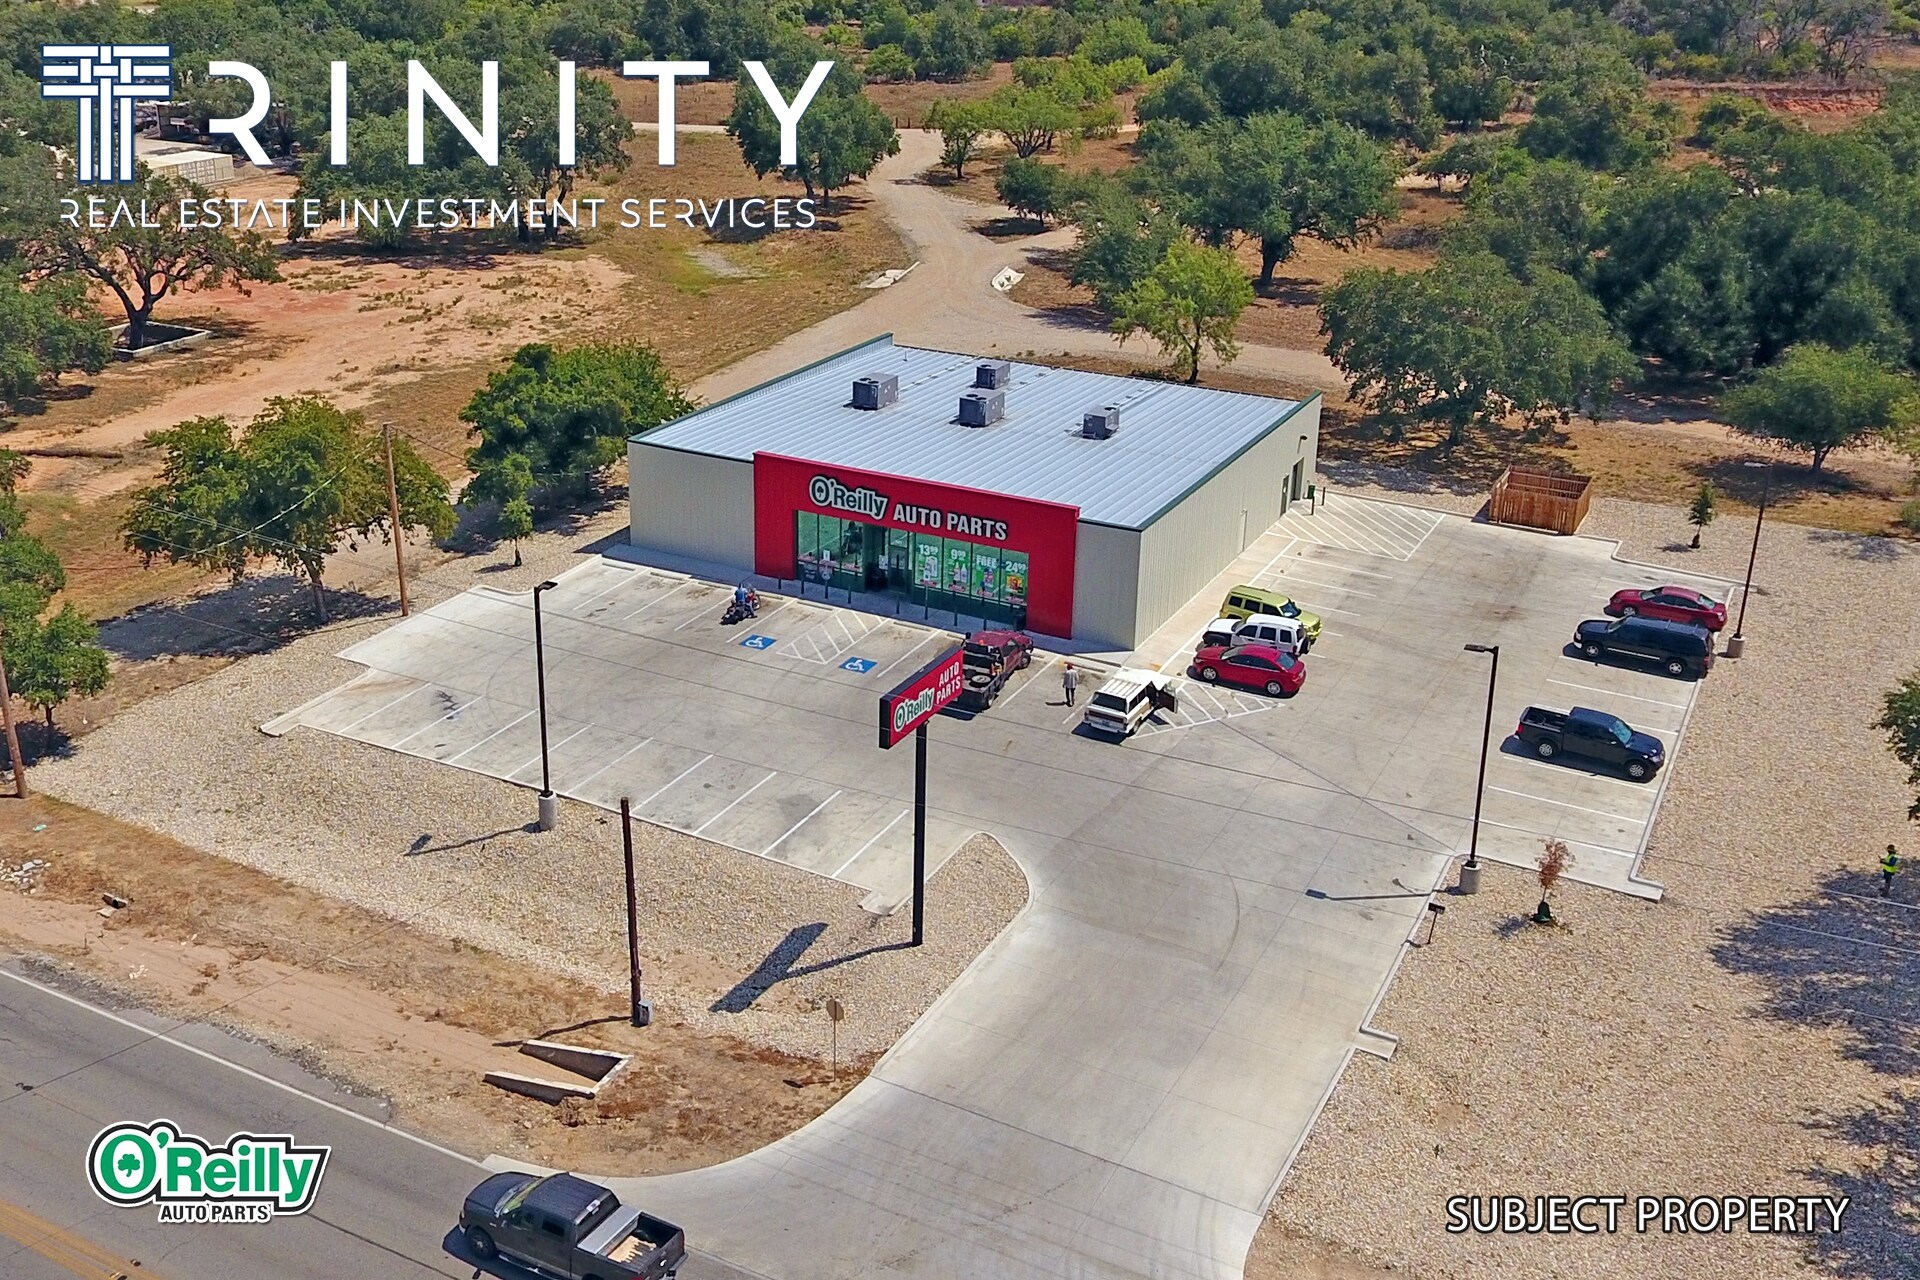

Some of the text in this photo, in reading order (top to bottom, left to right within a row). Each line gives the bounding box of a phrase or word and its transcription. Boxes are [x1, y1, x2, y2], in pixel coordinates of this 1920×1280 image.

[810, 476, 1007, 541] O'Reilly AUTO PARTS
[936, 675, 961, 705] PARTS
[938, 661, 960, 688] AUTO
[894, 688, 935, 732] O'Reilly
